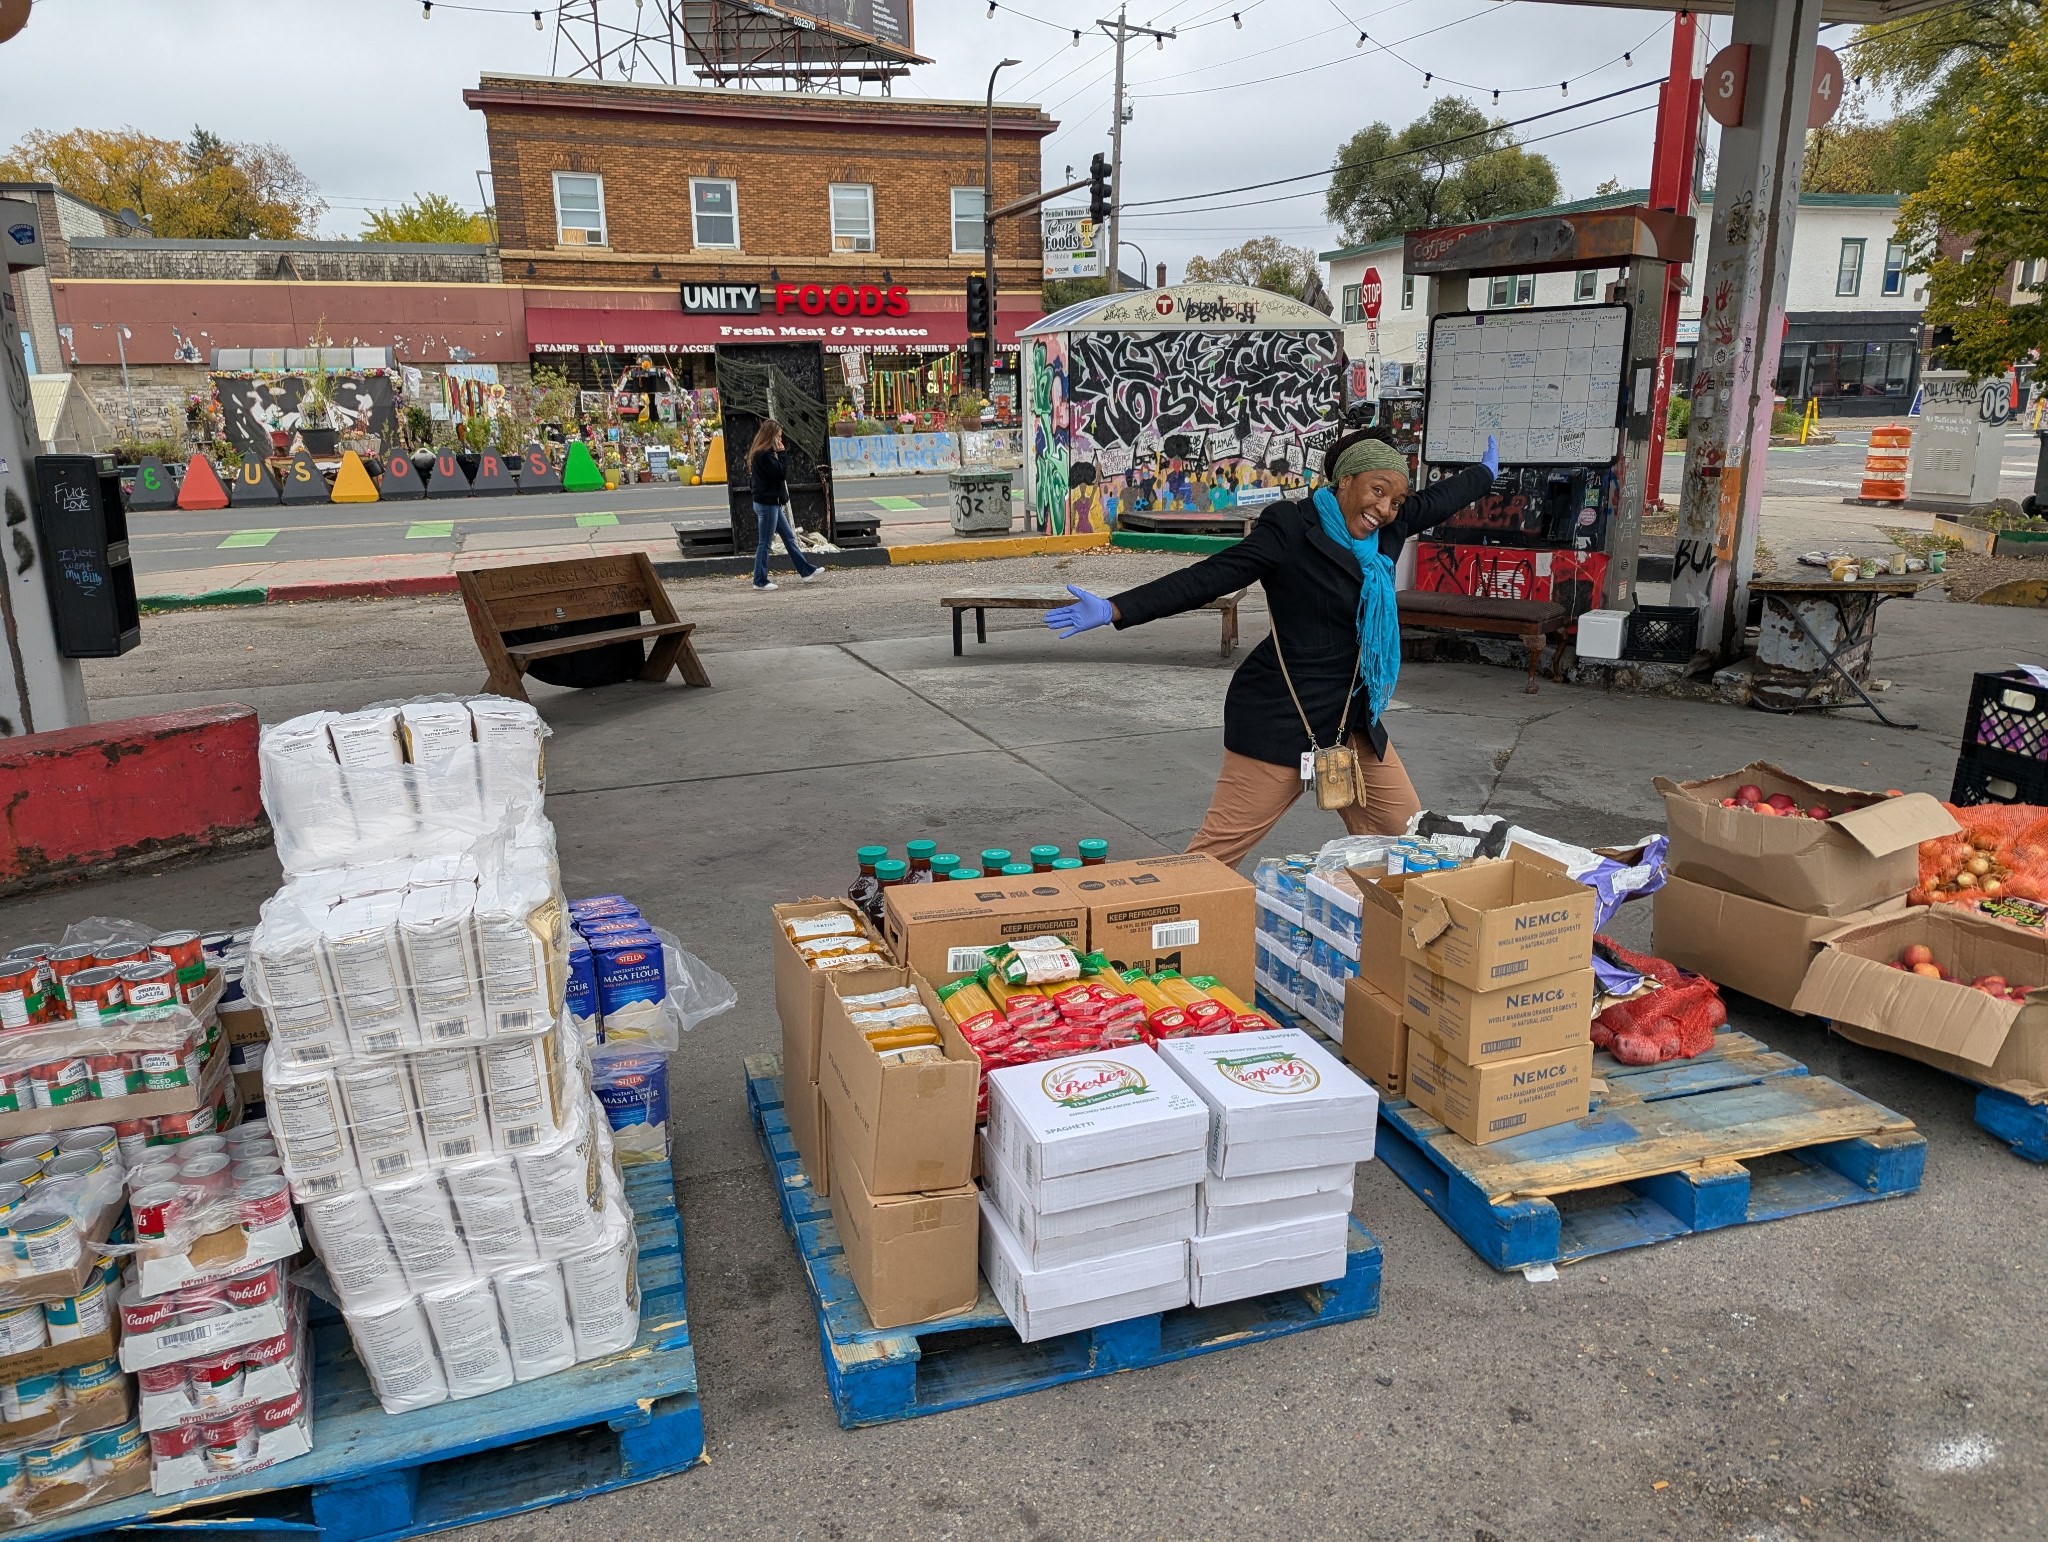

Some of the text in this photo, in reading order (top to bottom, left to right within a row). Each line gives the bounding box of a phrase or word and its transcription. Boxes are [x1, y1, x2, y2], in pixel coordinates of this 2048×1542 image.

[794, 16, 816, 31] 032570
[1719, 70, 1734, 98] 3
[1818, 72, 1832, 100] 4
[1048, 220, 1074, 237] Cup
[1044, 235, 1078, 250] Foods
[1414, 238, 1454, 260] Coffee
[684, 283, 910, 316] UNITY FOODS
[1363, 284, 1380, 303] STOP
[720, 326, 928, 336] Fresh Meat & Produce
[535, 344, 580, 352] STAMPS
[587, 345, 616, 353] KEYS
[624, 345, 666, 354] PHONES
[670, 345, 678, 353] &
[681, 345, 715, 354] ACCES
[826, 345, 871, 353] ORGANIC
[874, 345, 898, 353] MILK
[906, 345, 950, 353] T-SHIRTS
[1924, 383, 1939, 398] KILL
[533, 569, 580, 588] Street
[584, 562, 630, 583] Works
[1109, 906, 1179, 922] KEEP REFRIGERATED
[1003, 920, 1077, 933] KEEP REFRIGERATED
[1498, 923, 1581, 947] WHOLE MANDARIN ORANGE SEGMENTS
[1525, 939, 1543, 949] NATURAL
[1543, 937, 1559, 945] JUICE
[619, 953, 644, 962] STELLA
[1158, 960, 1179, 970] Minute
[604, 968, 660, 983] MASA FLOUR
[138, 986, 161, 994] PRIMA
[1488, 1002, 1578, 1025] WHOLE MANDARIN ORANGE SEGMENTS
[1517, 1018, 1539, 1027] NATURAL
[1540, 1015, 1553, 1023] JUICE
[630, 1089, 659, 1102] FLOUR
[1496, 1077, 1578, 1102] WHOLE MANDARIN ORANGE SEGMENTS
[1132, 1096, 1160, 1105] PRODUCT
[1524, 1094, 1542, 1104] NATURAL
[1542, 1091, 1557, 1099] JUICE
[1045, 1121, 1095, 1135] SPAGHETTI
